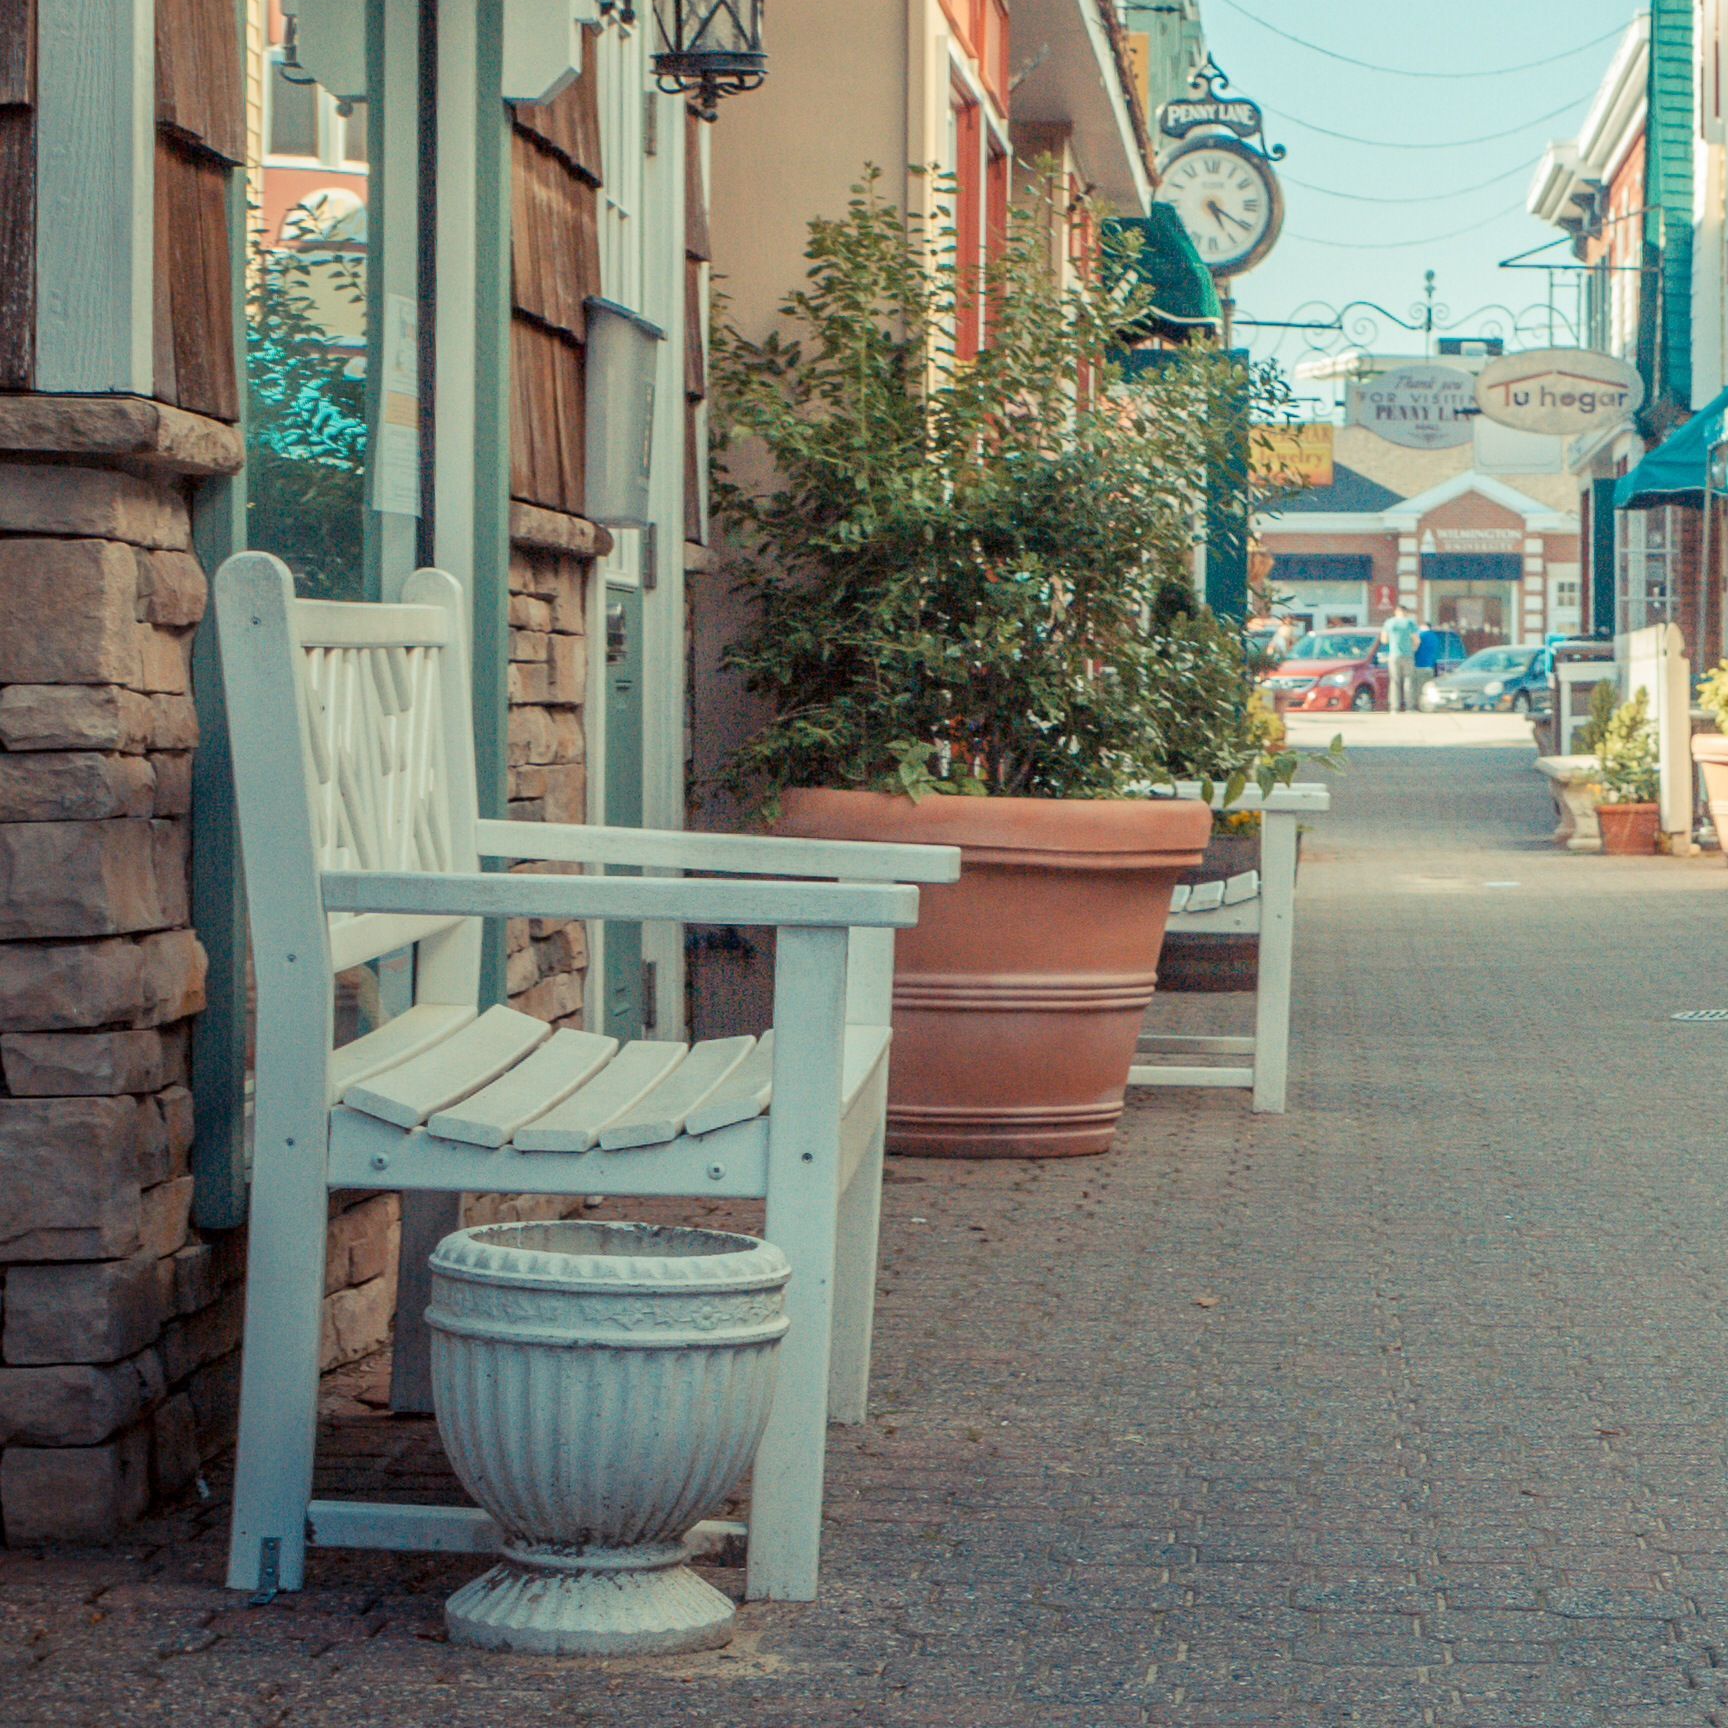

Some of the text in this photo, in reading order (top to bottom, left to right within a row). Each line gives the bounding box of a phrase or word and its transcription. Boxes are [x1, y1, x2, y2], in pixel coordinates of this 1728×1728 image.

[1168, 103, 1255, 127] PENNY LANE
[1356, 391, 1477, 405] FOR VISITIN
[1502, 382, 1629, 414] Tu hogar
